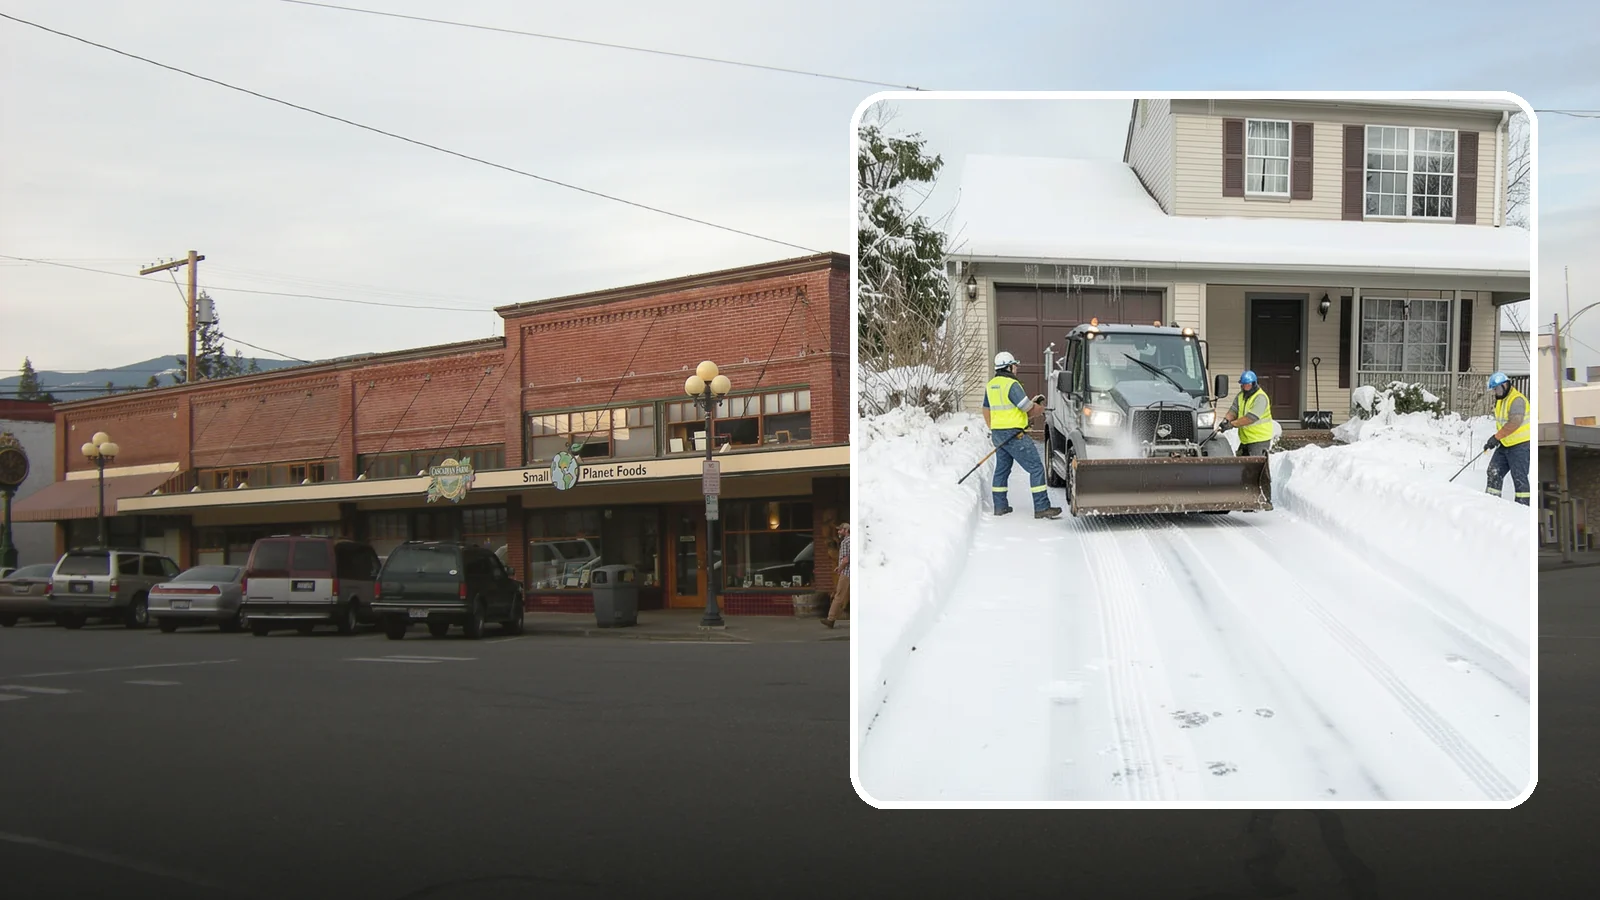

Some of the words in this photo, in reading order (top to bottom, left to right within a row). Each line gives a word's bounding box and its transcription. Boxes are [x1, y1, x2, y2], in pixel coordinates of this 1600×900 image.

[523, 471, 549, 483] Small
[582, 467, 614, 479] Planet
[616, 464, 647, 477] Foods
